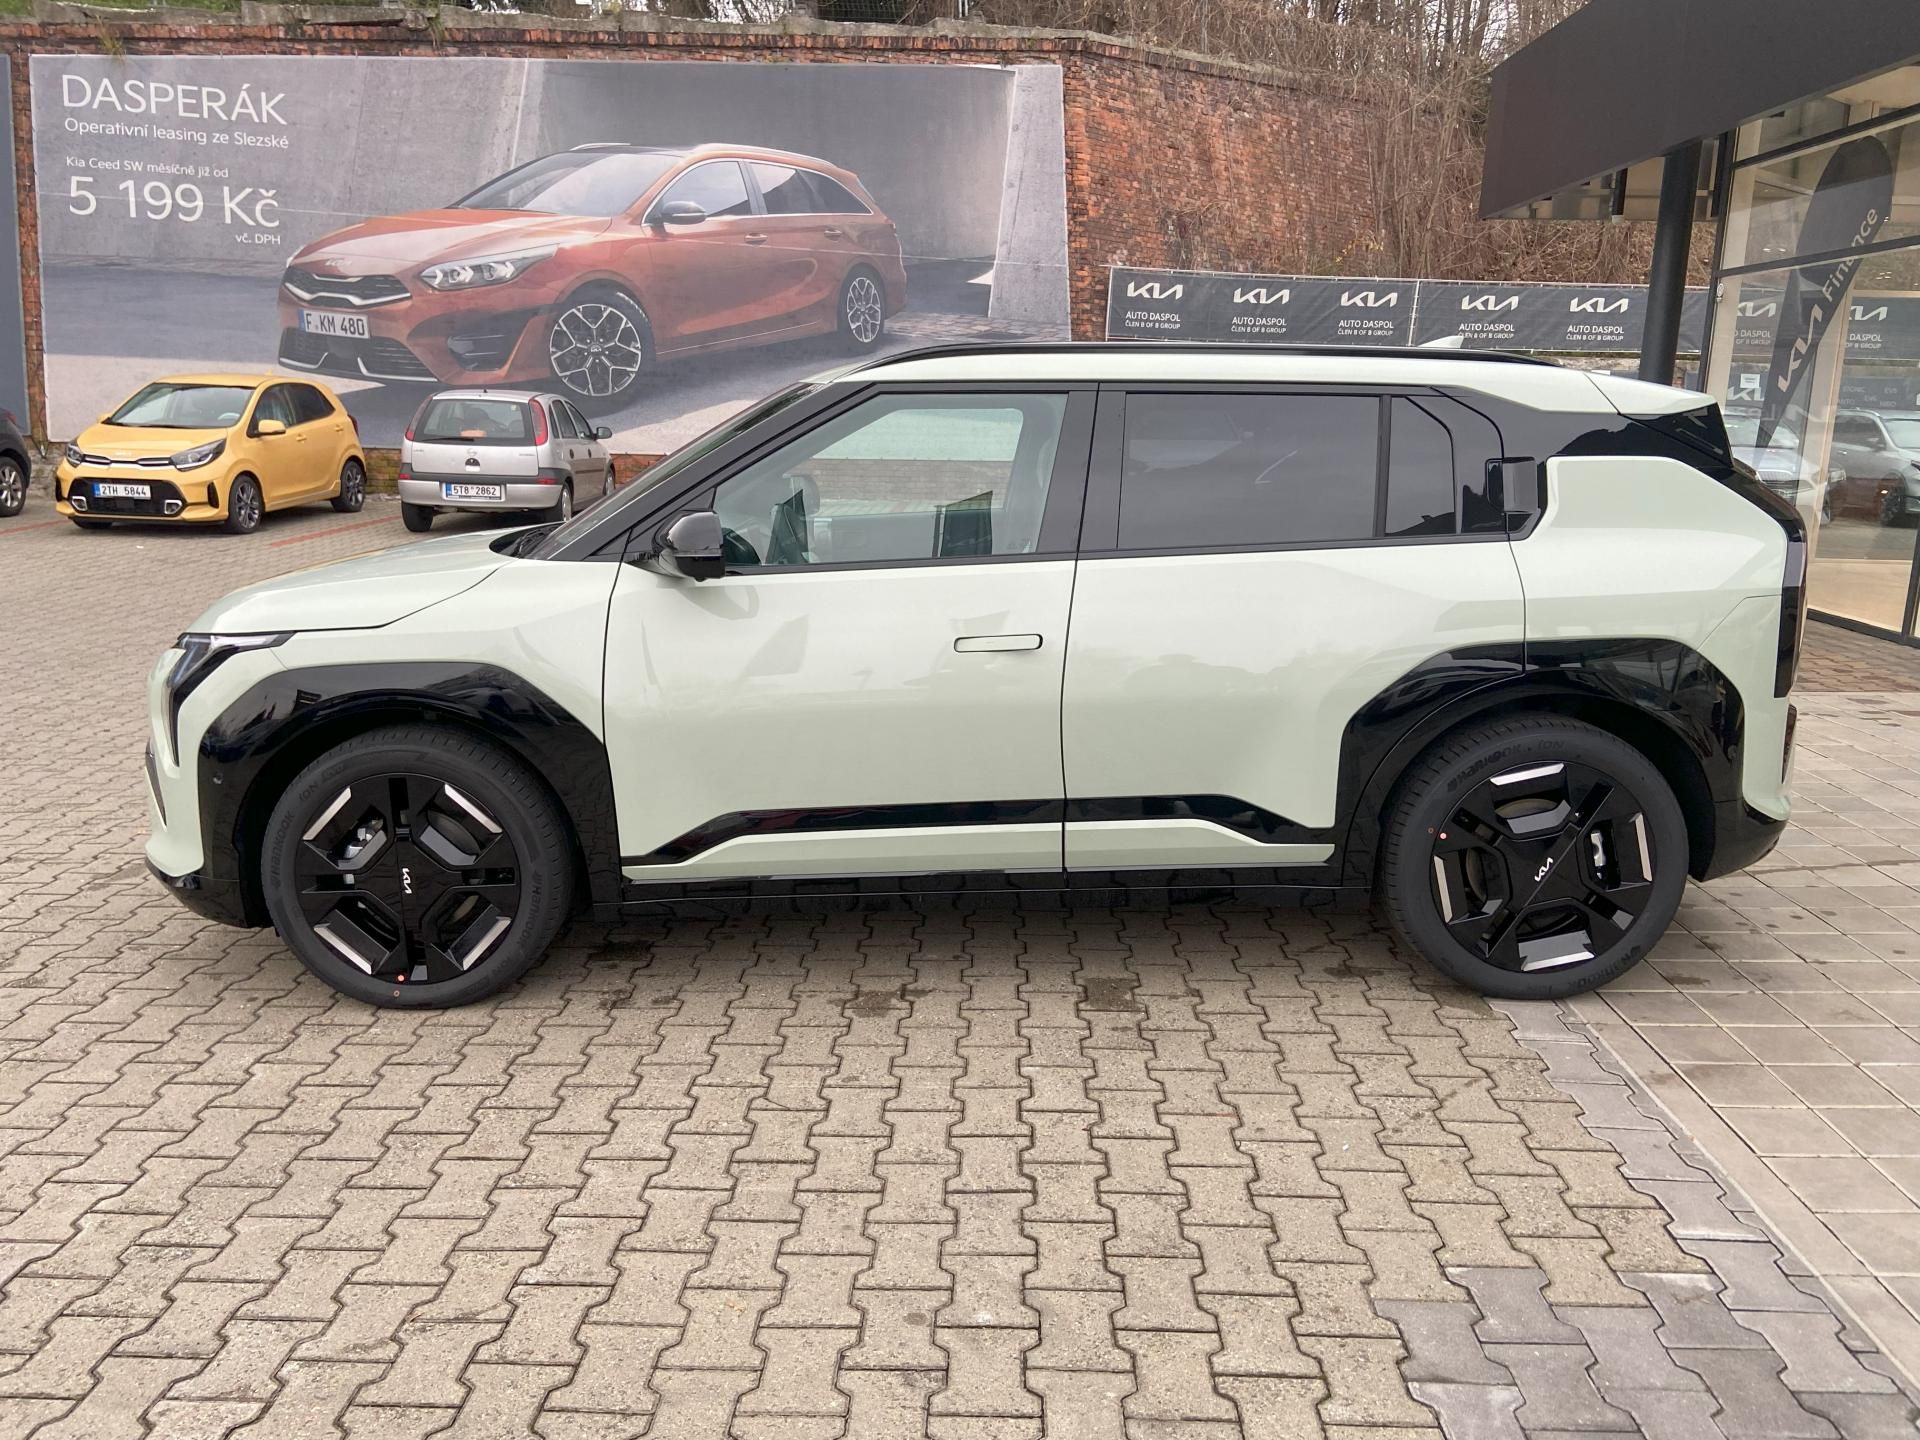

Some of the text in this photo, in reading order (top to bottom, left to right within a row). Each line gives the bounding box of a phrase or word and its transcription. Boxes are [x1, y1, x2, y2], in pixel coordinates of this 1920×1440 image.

[62, 74, 287, 125] DASPERÁK
[64, 118, 289, 149] Operativní leasing ze Slezské
[66, 156, 229, 179] Kia Ceed SW měsíčně již od
[69, 175, 280, 228] 5 199 Kč
[235, 232, 281, 246] vč. DPH
[1127, 280, 1183, 300] KIA
[1233, 287, 1290, 305] KIA
[1341, 291, 1398, 308] KIA
[1461, 294, 1519, 311] KIA
[1570, 296, 1629, 314] KIA
[1126, 311, 1181, 322] AUTO DASPOL
[1232, 316, 1287, 326] AUTO DASPOL
[1849, 305, 1888, 321] IA
[305, 313, 365, 336] F KM 480
[1339, 320, 1394, 329] AUTO DASPOL
[1459, 323, 1515, 332] AUTO DASPOL
[1567, 325, 1625, 334] AUTO DASPOL
[1740, 329, 1771, 338] DASPOL
[1849, 333, 1882, 341] DASPOL
[1777, 304, 1823, 393] KIA
[1727, 386, 1764, 401] KI
[102, 485, 146, 496] 2TH 5844
[453, 485, 497, 496] 5T8 2862
[1534, 857, 1554, 882] KIA
[402, 867, 413, 894] KIA
